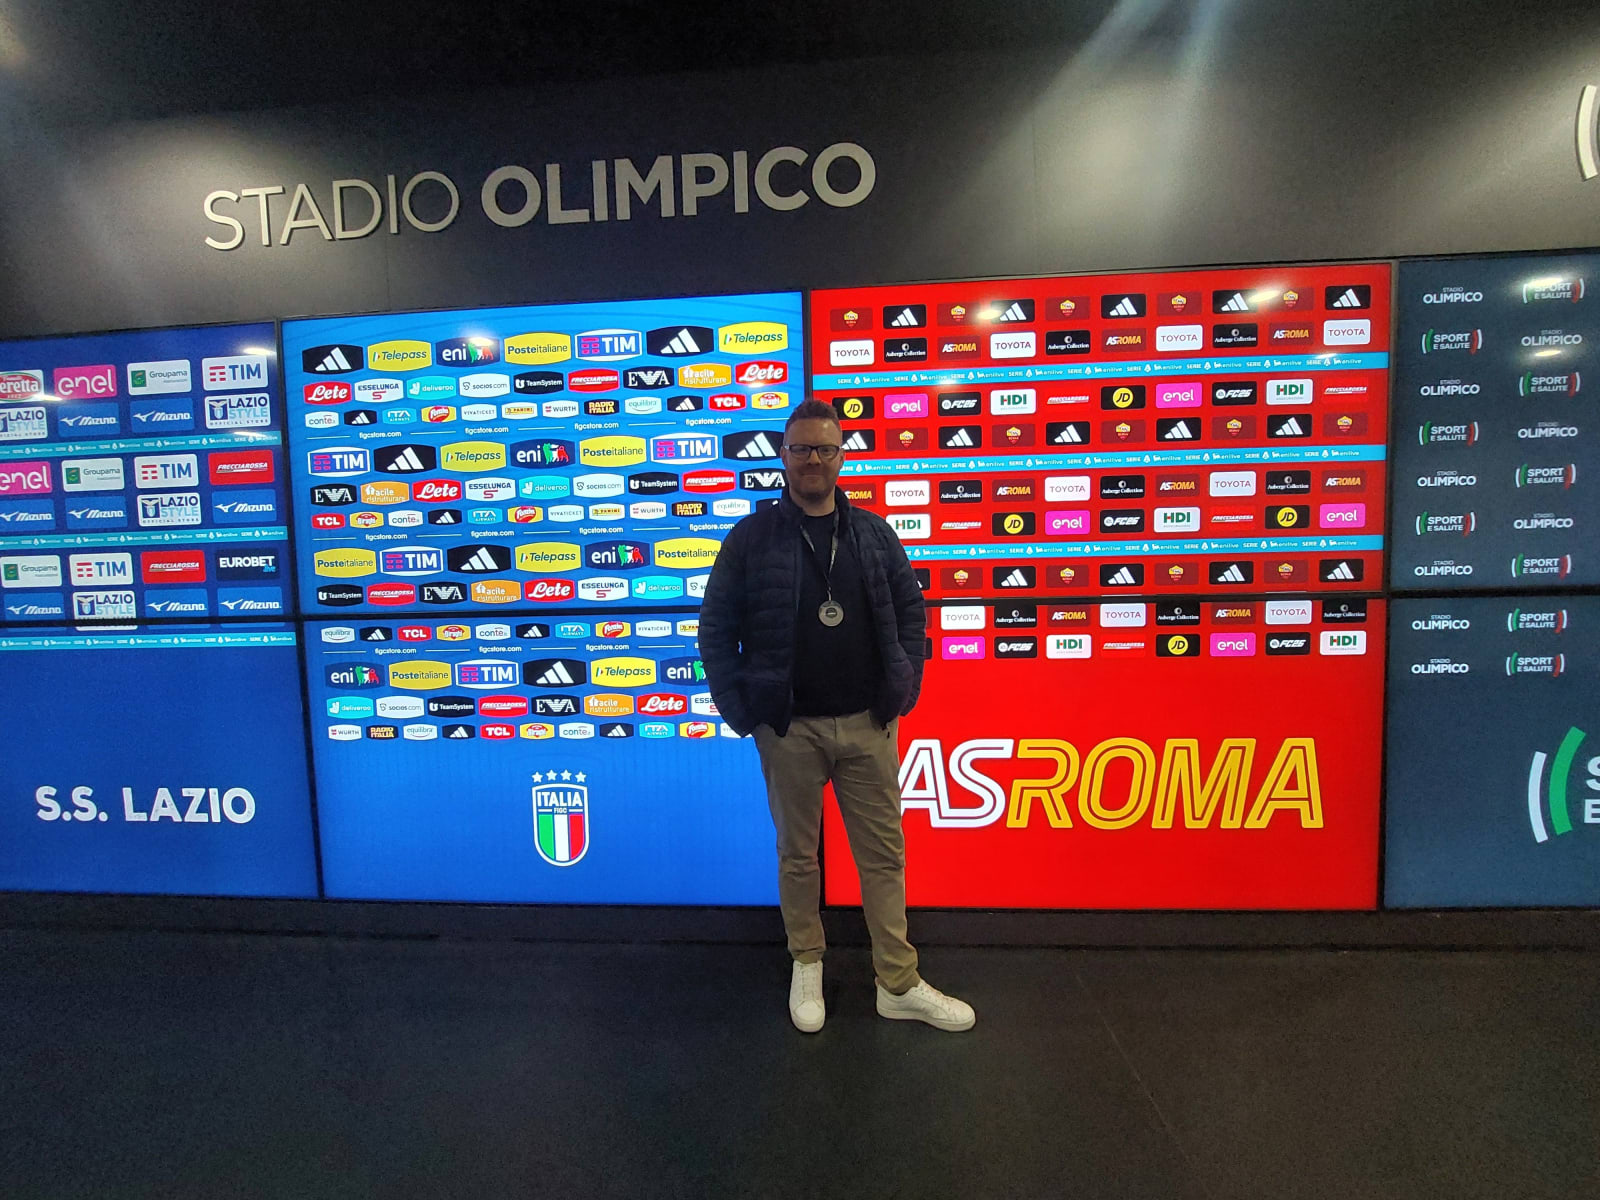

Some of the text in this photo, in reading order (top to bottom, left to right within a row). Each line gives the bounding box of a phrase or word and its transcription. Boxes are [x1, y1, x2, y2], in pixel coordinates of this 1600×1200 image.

[204, 142, 876, 250] STADIO OLIMPICO
[1423, 292, 1483, 304] OLIMPICO
[733, 332, 783, 344] Telepass
[1328, 328, 1365, 337] TOYOTA
[1434, 333, 1470, 343] SPORT
[1161, 334, 1198, 343] TOYOTA
[1521, 334, 1582, 346] OLIMPICO
[507, 344, 568, 355] Posteitaliane
[602, 336, 635, 353] TIM
[995, 341, 1032, 350] TOYOTA
[382, 350, 427, 361] Telepass
[442, 344, 466, 361] eni
[835, 348, 870, 358] TOYOTA
[149, 369, 188, 379] Groupama
[232, 364, 261, 380] TIM
[739, 366, 784, 381] Lete
[57, 369, 114, 395] enel
[526, 378, 562, 386] TeamSystem
[1531, 376, 1568, 385] SPORT
[0, 380, 38, 393] eretta
[358, 383, 399, 391] ESSELUNGA
[422, 384, 453, 392] deliveroo
[1276, 384, 1304, 396] HDI
[1420, 384, 1480, 396] OLIMPICO
[308, 385, 347, 401] Lete
[1116, 393, 1130, 402] JD
[1163, 389, 1194, 402] enel
[229, 396, 267, 408] LAZIO
[714, 397, 741, 407] TCL
[1000, 394, 1027, 405] HDI
[229, 407, 268, 418] STYLE
[847, 403, 860, 413] JD
[891, 401, 921, 413] enel
[8, 410, 45, 421] LAZIO
[10, 420, 45, 430] STYLE
[574, 422, 619, 430] figcstore.com
[685, 417, 731, 426] figcstore.com
[359, 431, 401, 439] figcstore.com
[465, 426, 509, 434] figcstore.com
[517, 445, 541, 462] eni
[583, 446, 643, 457] Posteitaliane
[678, 440, 711, 457] TIM
[333, 454, 364, 470] TIM
[455, 451, 501, 462] Telepass
[83, 467, 121, 477] Groupama
[160, 463, 192, 479] TIM
[469, 482, 512, 490] ESSELUNGA
[587, 482, 621, 490] socios.com
[641, 479, 677, 487] TeamSystem
[1215, 480, 1251, 488] TOYOTA
[417, 483, 458, 499] Lete
[890, 489, 925, 498] TOYOTA
[160, 496, 198, 507] LAZIO
[161, 506, 199, 517] STYLE
[1280, 512, 1294, 522] JD
[1327, 511, 1357, 522] enel
[317, 517, 340, 526] TCL
[895, 519, 921, 530] HDI
[1052, 517, 1082, 529] enel
[1428, 516, 1463, 525] SPORT
[1514, 518, 1573, 529] OLIMPICO
[365, 533, 407, 541] figcstore.com
[530, 552, 576, 562] Telepass
[591, 547, 616, 564] eni
[657, 548, 718, 559] Posteitaliane
[219, 555, 275, 569] EUROBET
[317, 558, 373, 568] Posteitaliane
[405, 554, 437, 569] TIM
[21, 564, 58, 574] Groupama
[95, 561, 126, 577] TIM
[528, 582, 570, 598] Lete
[581, 582, 624, 590] ESSELUNGA
[648, 583, 680, 591] deliveroo
[95, 594, 133, 604] LAZIO
[1105, 611, 1141, 619] TOYOTA
[1271, 608, 1307, 616] TOYOTA
[1412, 620, 1469, 630] OLIMPICO
[402, 629, 426, 638] TCL
[1330, 635, 1357, 646] HDI
[586, 643, 629, 651] figcstore.com
[949, 642, 978, 654] enel
[1518, 657, 1553, 666] SPORT
[605, 667, 651, 678] Telepass
[667, 662, 691, 679] eni
[1411, 663, 1469, 674] OLIMPICO
[331, 668, 353, 684] eni
[392, 671, 448, 680] Posteitaliane
[480, 667, 513, 682] TIM
[641, 696, 683, 712] Lete
[486, 728, 510, 736] TCL
[899, 737, 1324, 830] ASROMA
[537, 792, 583, 806] ITALIA
[35, 786, 256, 824] S.S. LAZIO
